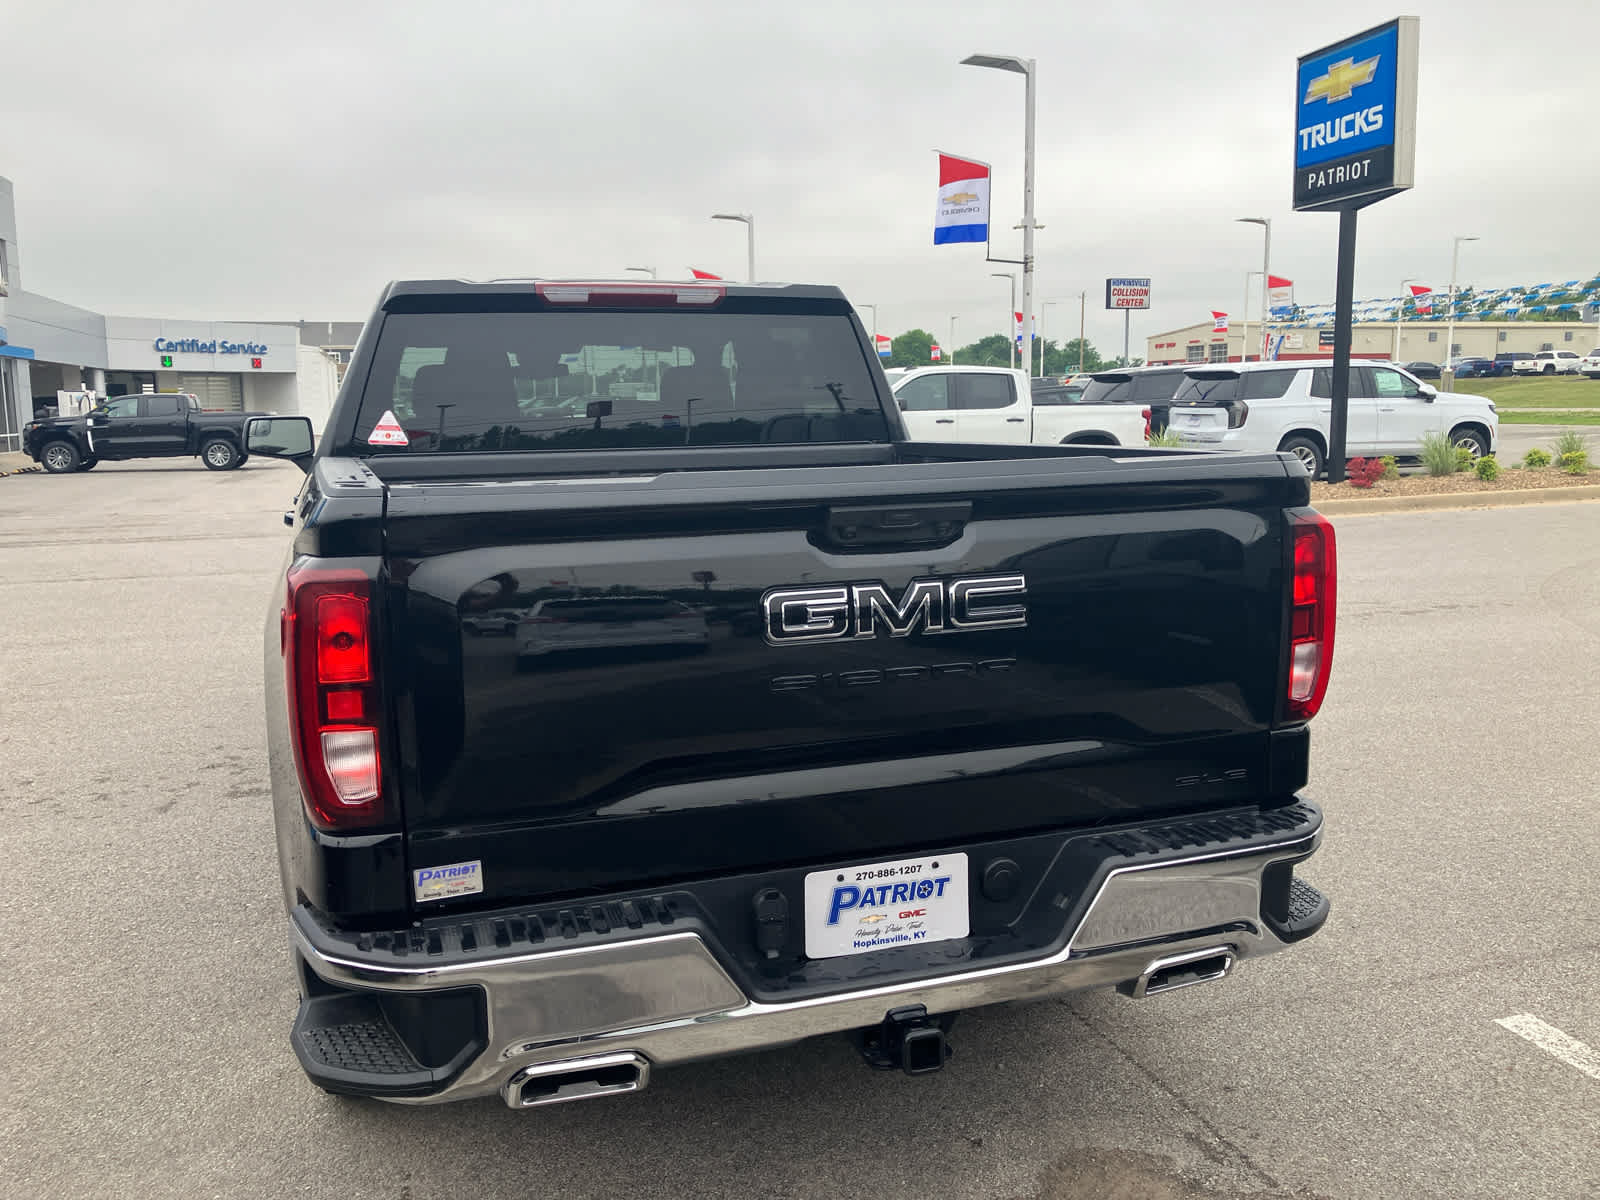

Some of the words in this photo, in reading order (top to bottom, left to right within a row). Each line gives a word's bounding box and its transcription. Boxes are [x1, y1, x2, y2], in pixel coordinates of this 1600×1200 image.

[1299, 104, 1383, 151] TRUCKS
[1308, 159, 1372, 190] PATRIOT
[1112, 287, 1149, 297] COLLISION
[1116, 297, 1144, 307] CENTER
[155, 337, 217, 354] Certified
[219, 340, 268, 354] Service
[761, 573, 1027, 646] GMC
[417, 864, 478, 887] PATRIOT
[856, 864, 923, 881] 270-886-1207
[827, 876, 951, 926] PATRIOT
[899, 908, 926, 919] GMC
[853, 934, 912, 948] Hopkinsville,
[913, 930, 927, 939] KY
